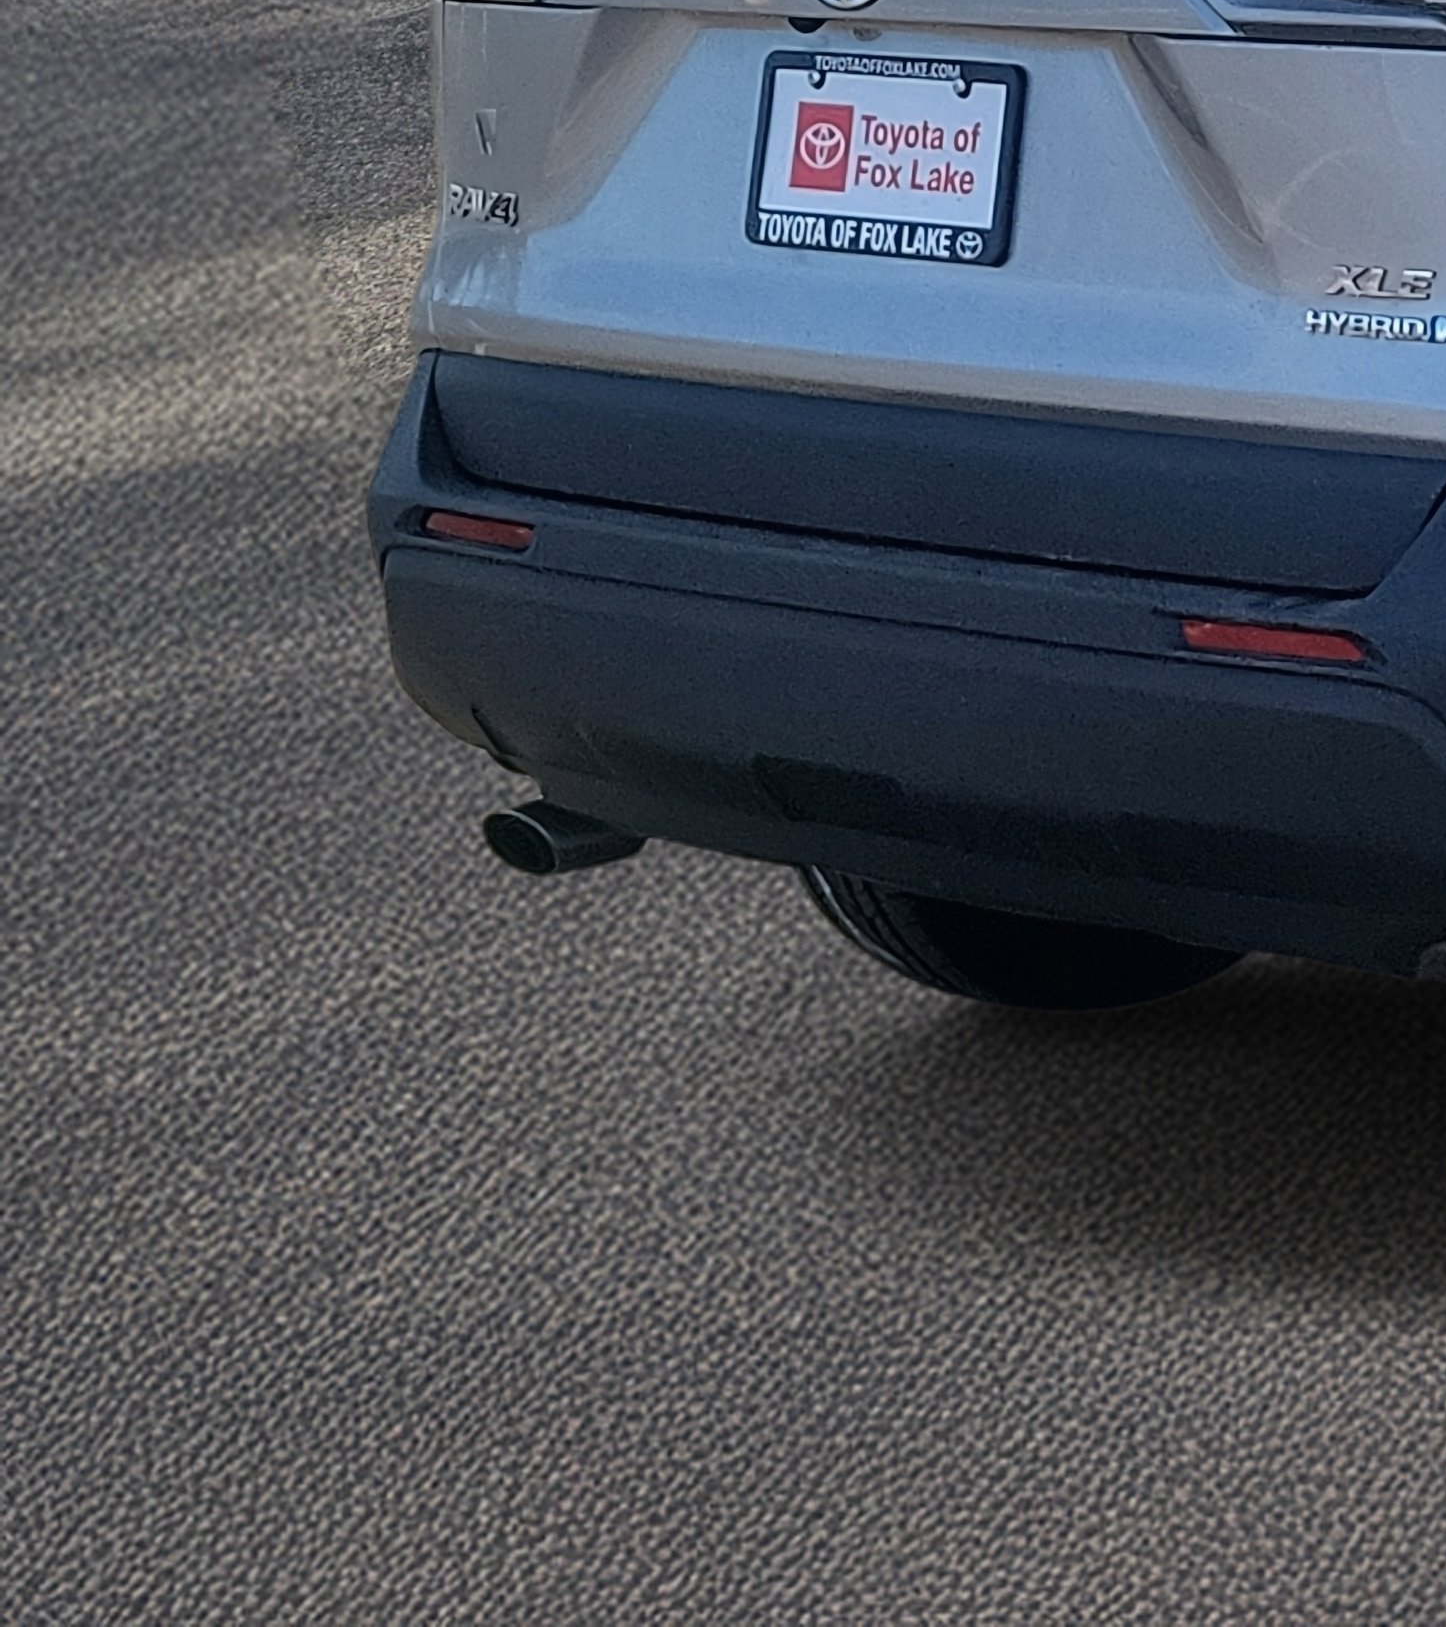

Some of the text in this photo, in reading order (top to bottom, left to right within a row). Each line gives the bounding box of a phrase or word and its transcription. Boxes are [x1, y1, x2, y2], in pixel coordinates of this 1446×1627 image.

[861, 114, 981, 155] Toyota of
[854, 155, 974, 195] Fox Lake
[449, 183, 518, 227] RAV4
[758, 212, 952, 258] TOYOTA OF FOX LAKE
[1325, 265, 1436, 300] XLE
[1304, 308, 1428, 341] HYBRID
